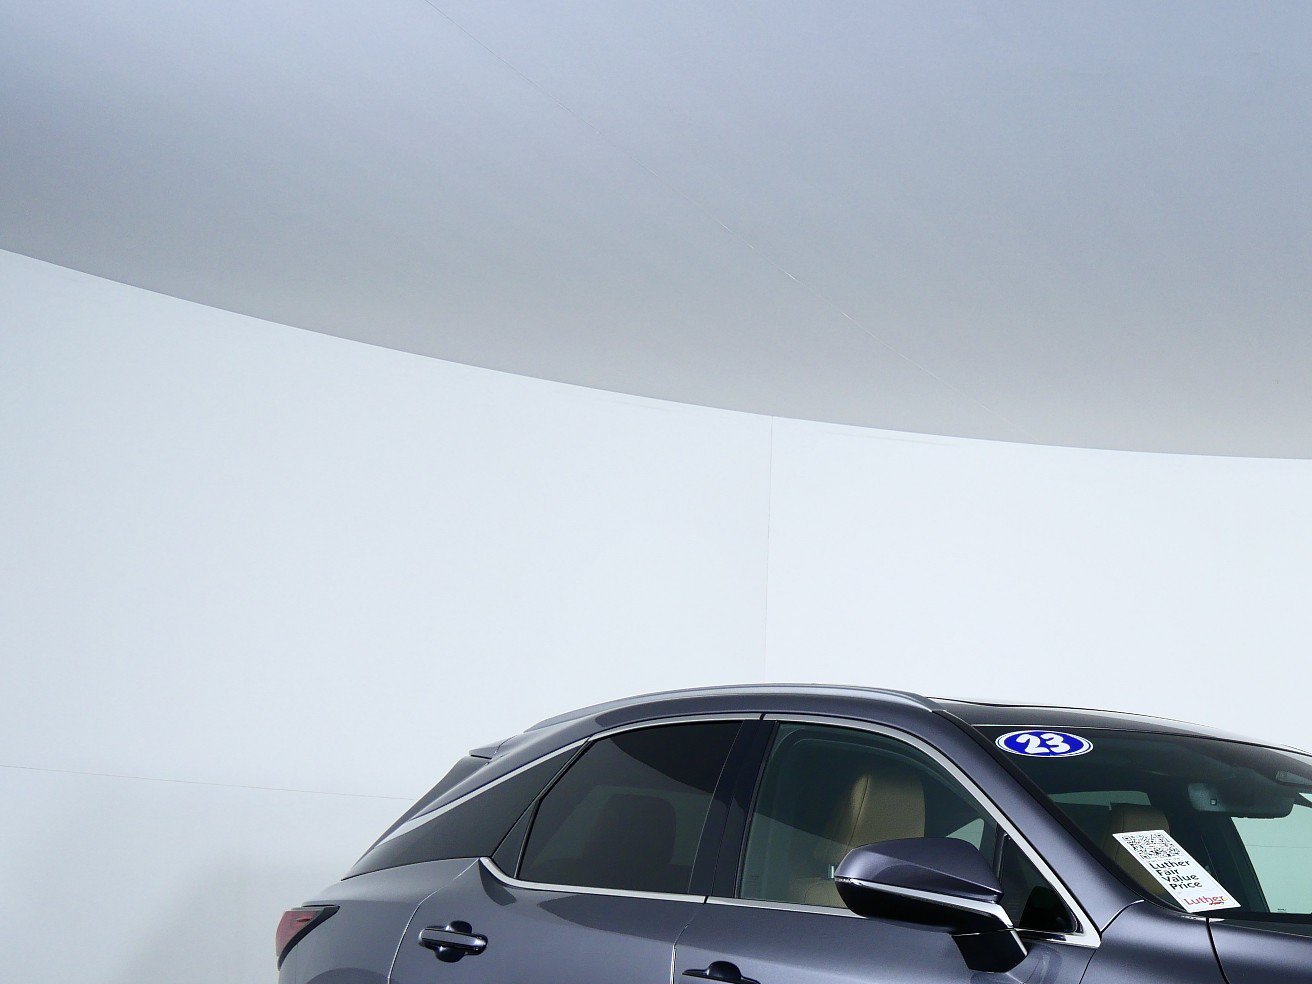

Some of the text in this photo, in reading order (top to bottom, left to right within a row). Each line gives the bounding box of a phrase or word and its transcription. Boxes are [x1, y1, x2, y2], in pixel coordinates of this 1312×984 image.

[1016, 733, 1071, 754] 23
[1150, 860, 1191, 870] Luther
[1155, 868, 1180, 877] Fair
[1161, 873, 1200, 883] Value
[1169, 881, 1203, 890] Price
[1183, 895, 1228, 906] Luther
